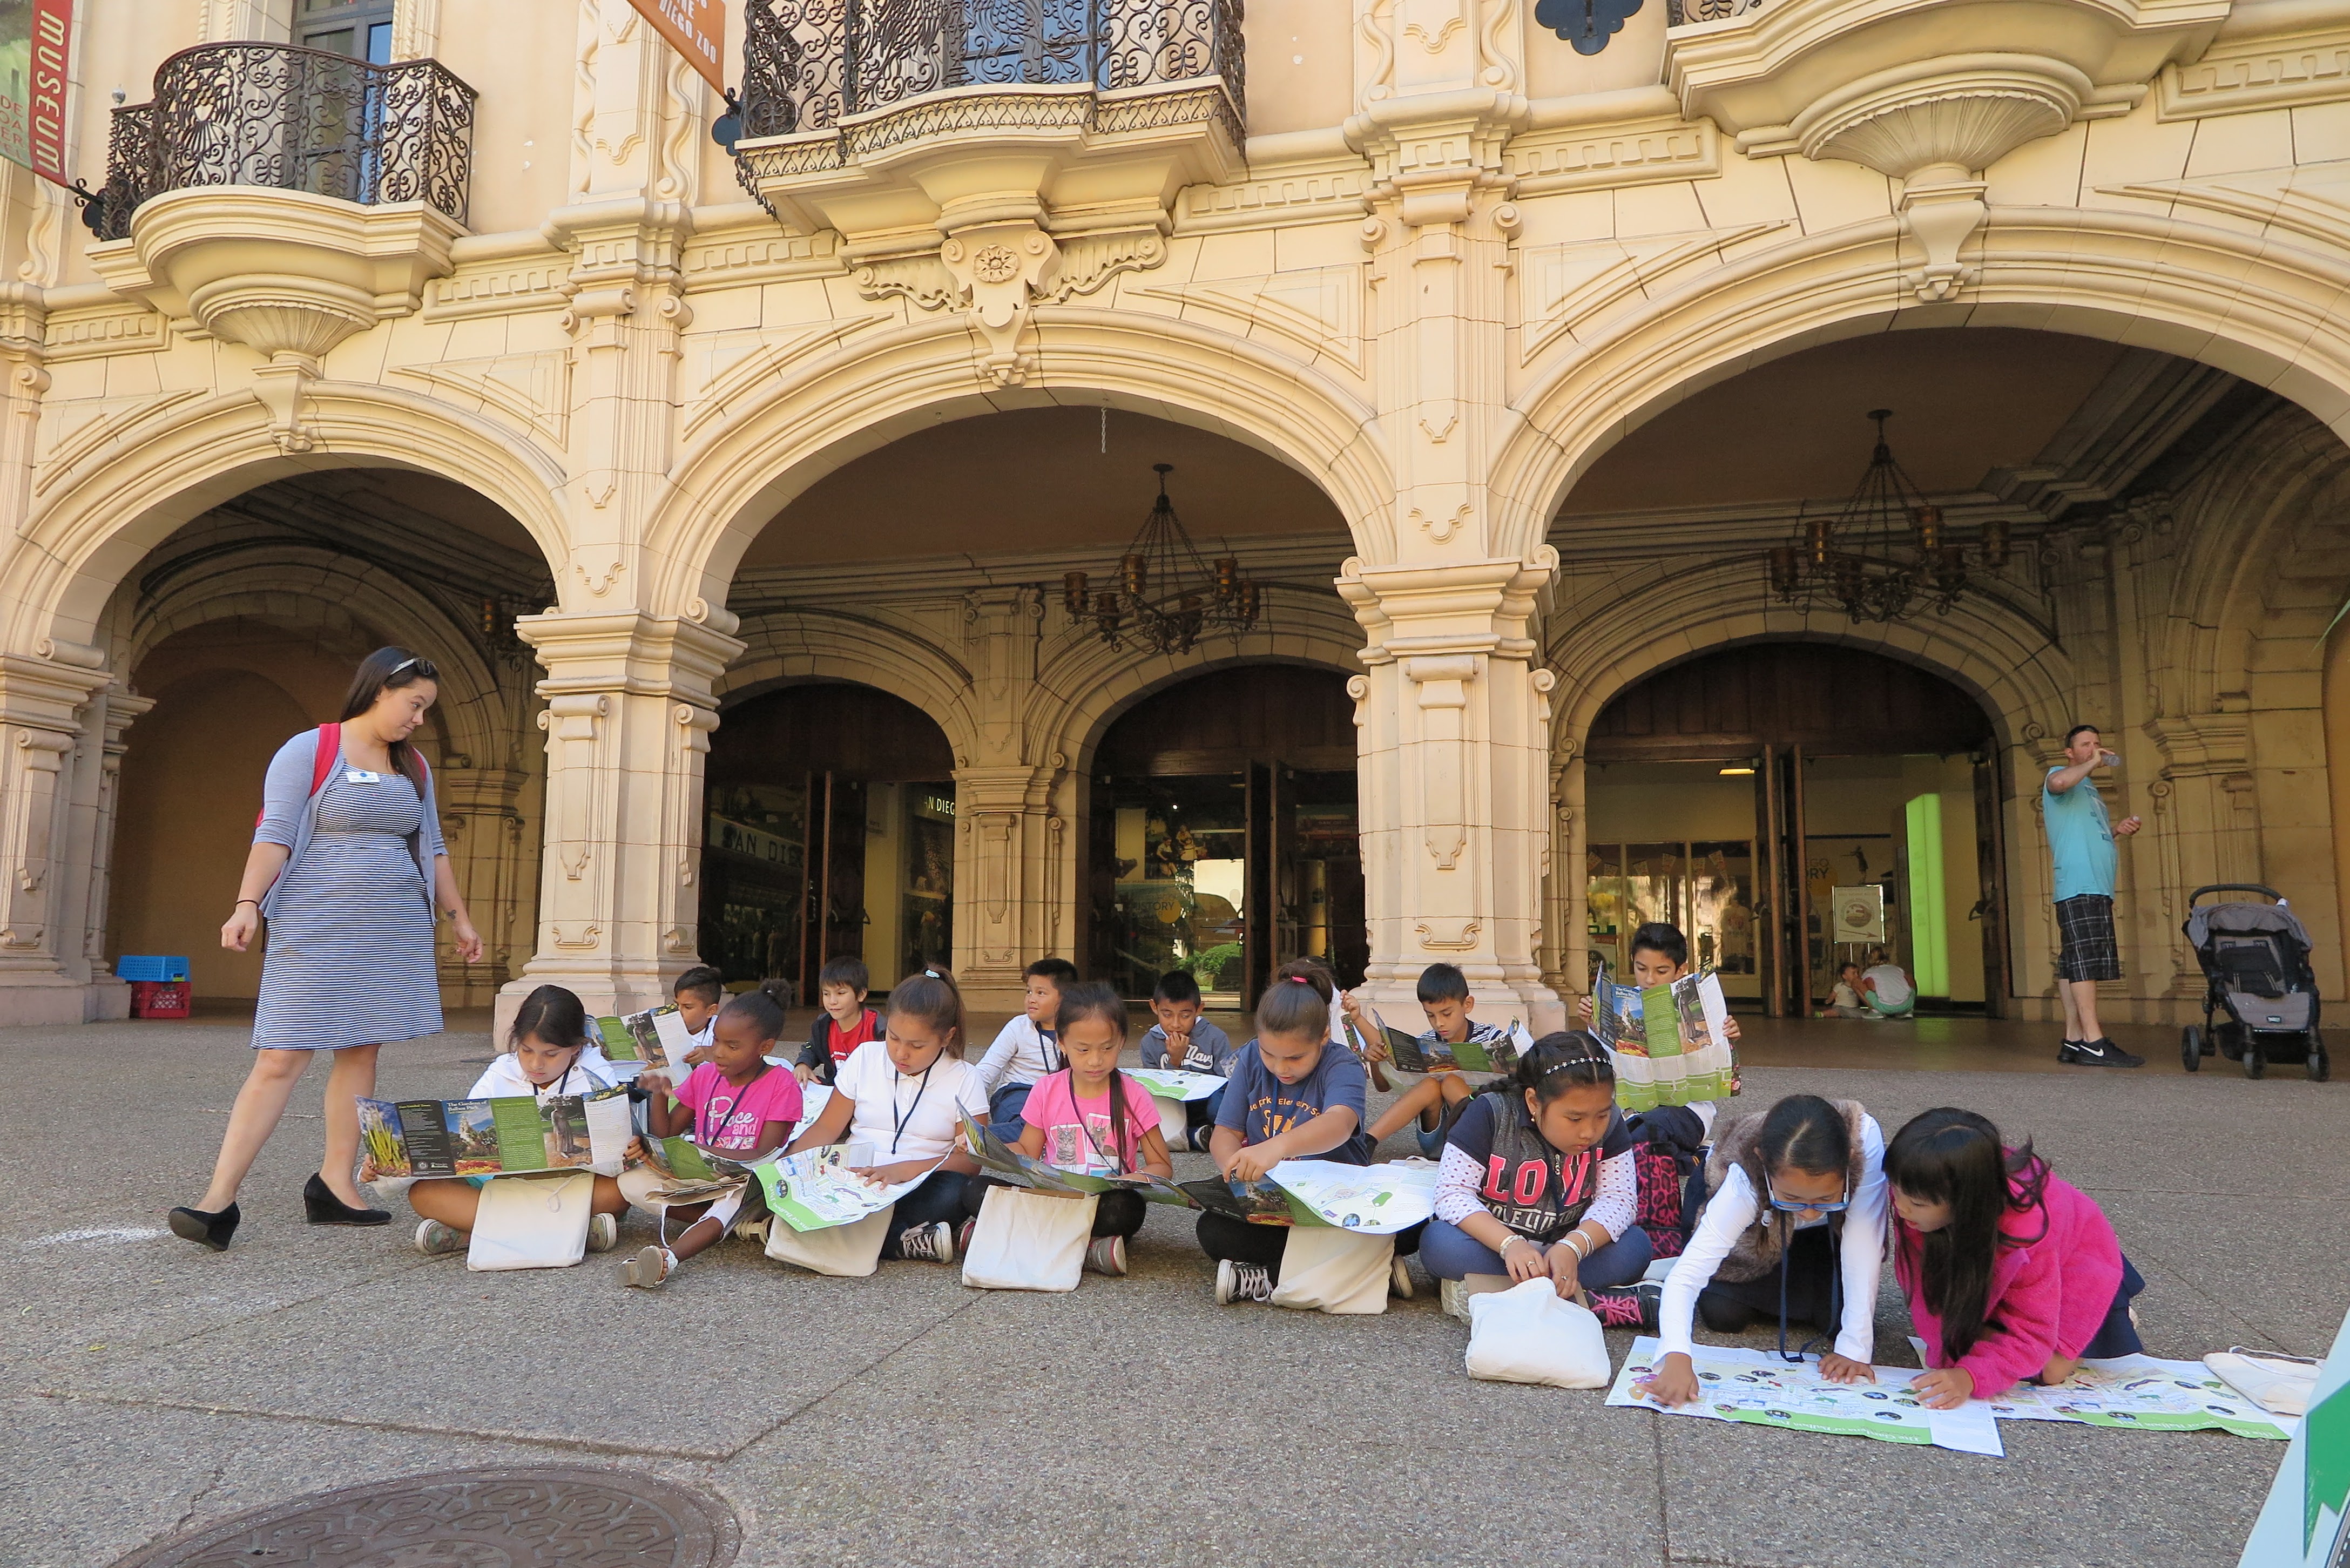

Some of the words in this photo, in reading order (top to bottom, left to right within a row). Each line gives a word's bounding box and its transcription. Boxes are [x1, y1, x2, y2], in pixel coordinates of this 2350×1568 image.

[659, 0, 693, 39] DIEGO
[696, 30, 717, 64] ZOO
[35, 9, 65, 174] MUSEUM
[732, 1117, 759, 1135] and
[1483, 1147, 1603, 1207] LOV
